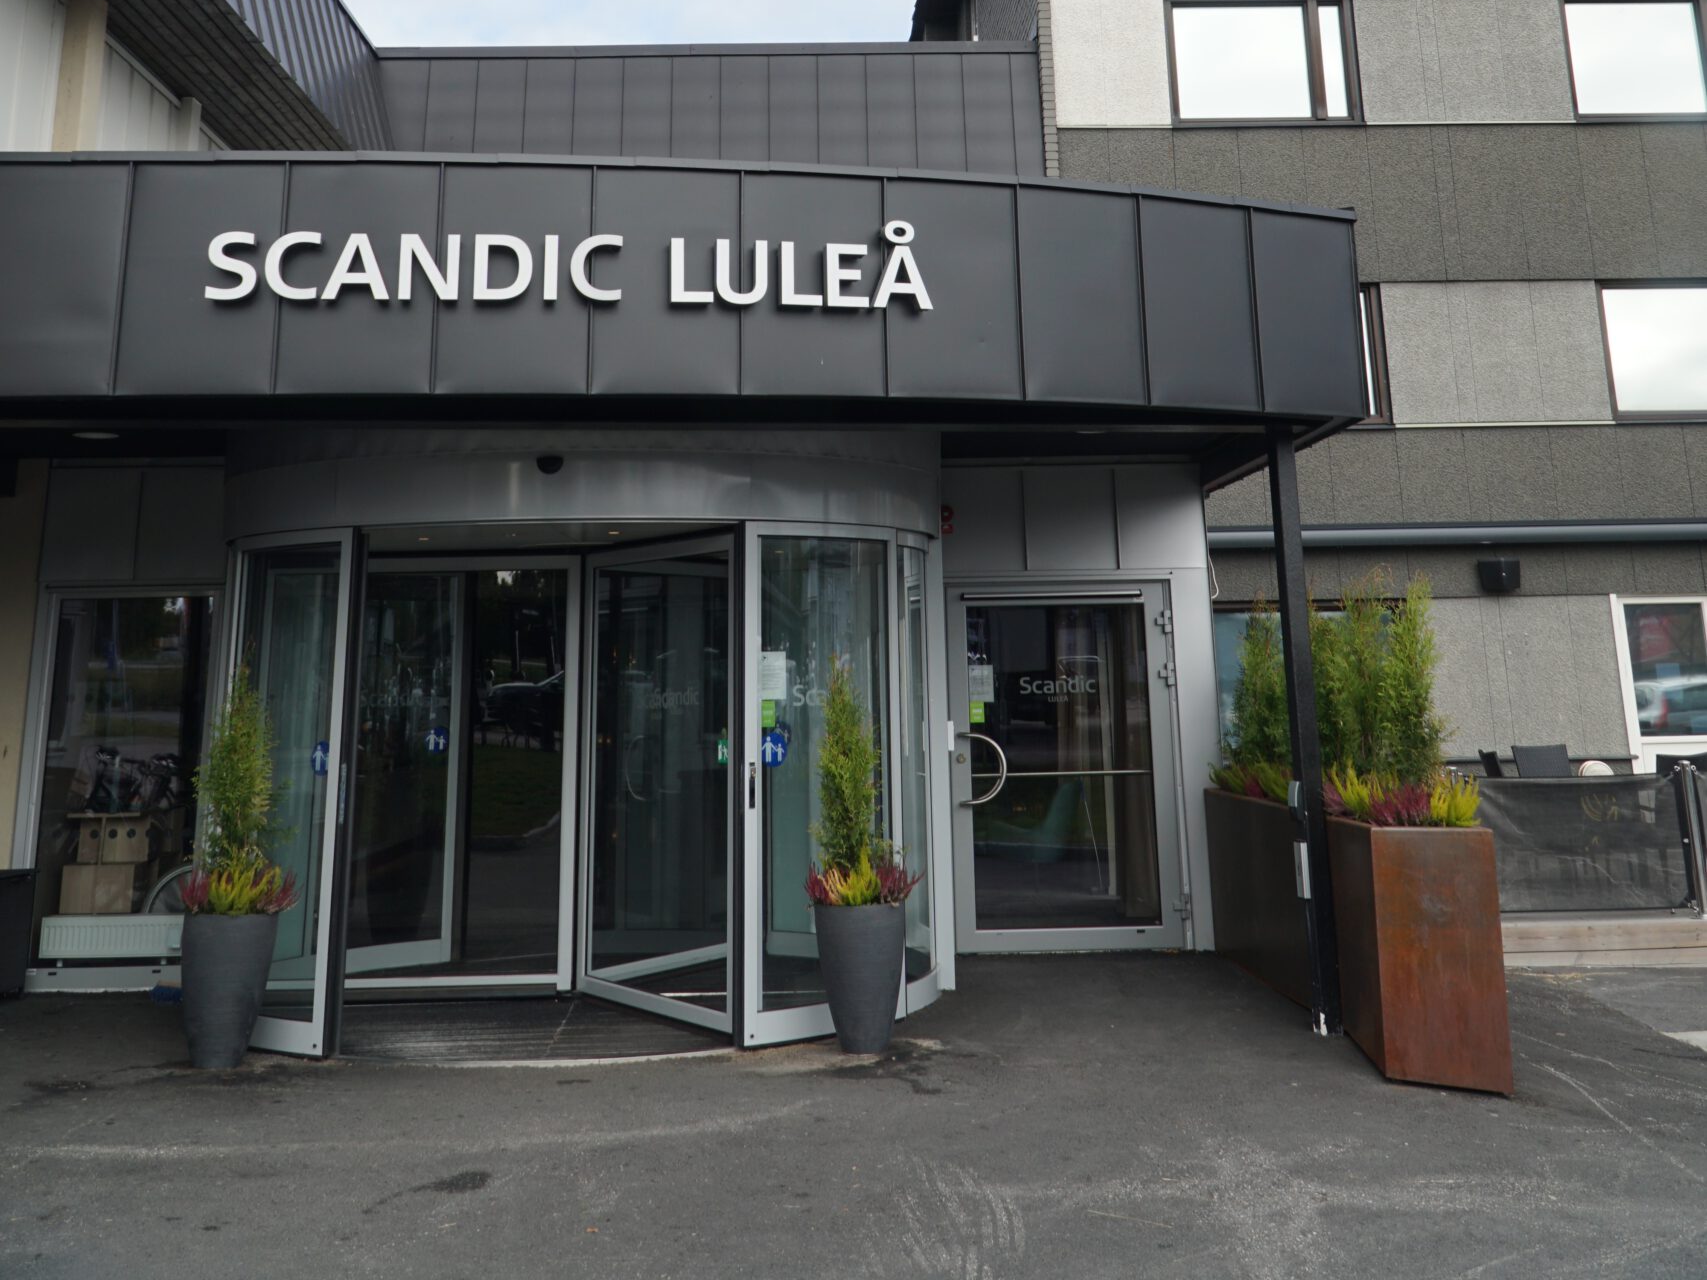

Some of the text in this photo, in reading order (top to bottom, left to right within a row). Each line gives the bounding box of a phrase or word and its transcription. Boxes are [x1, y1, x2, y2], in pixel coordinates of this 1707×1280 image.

[204, 220, 934, 311] SCANDIC LULEÅ
[1019, 675, 1096, 694] Scandic
